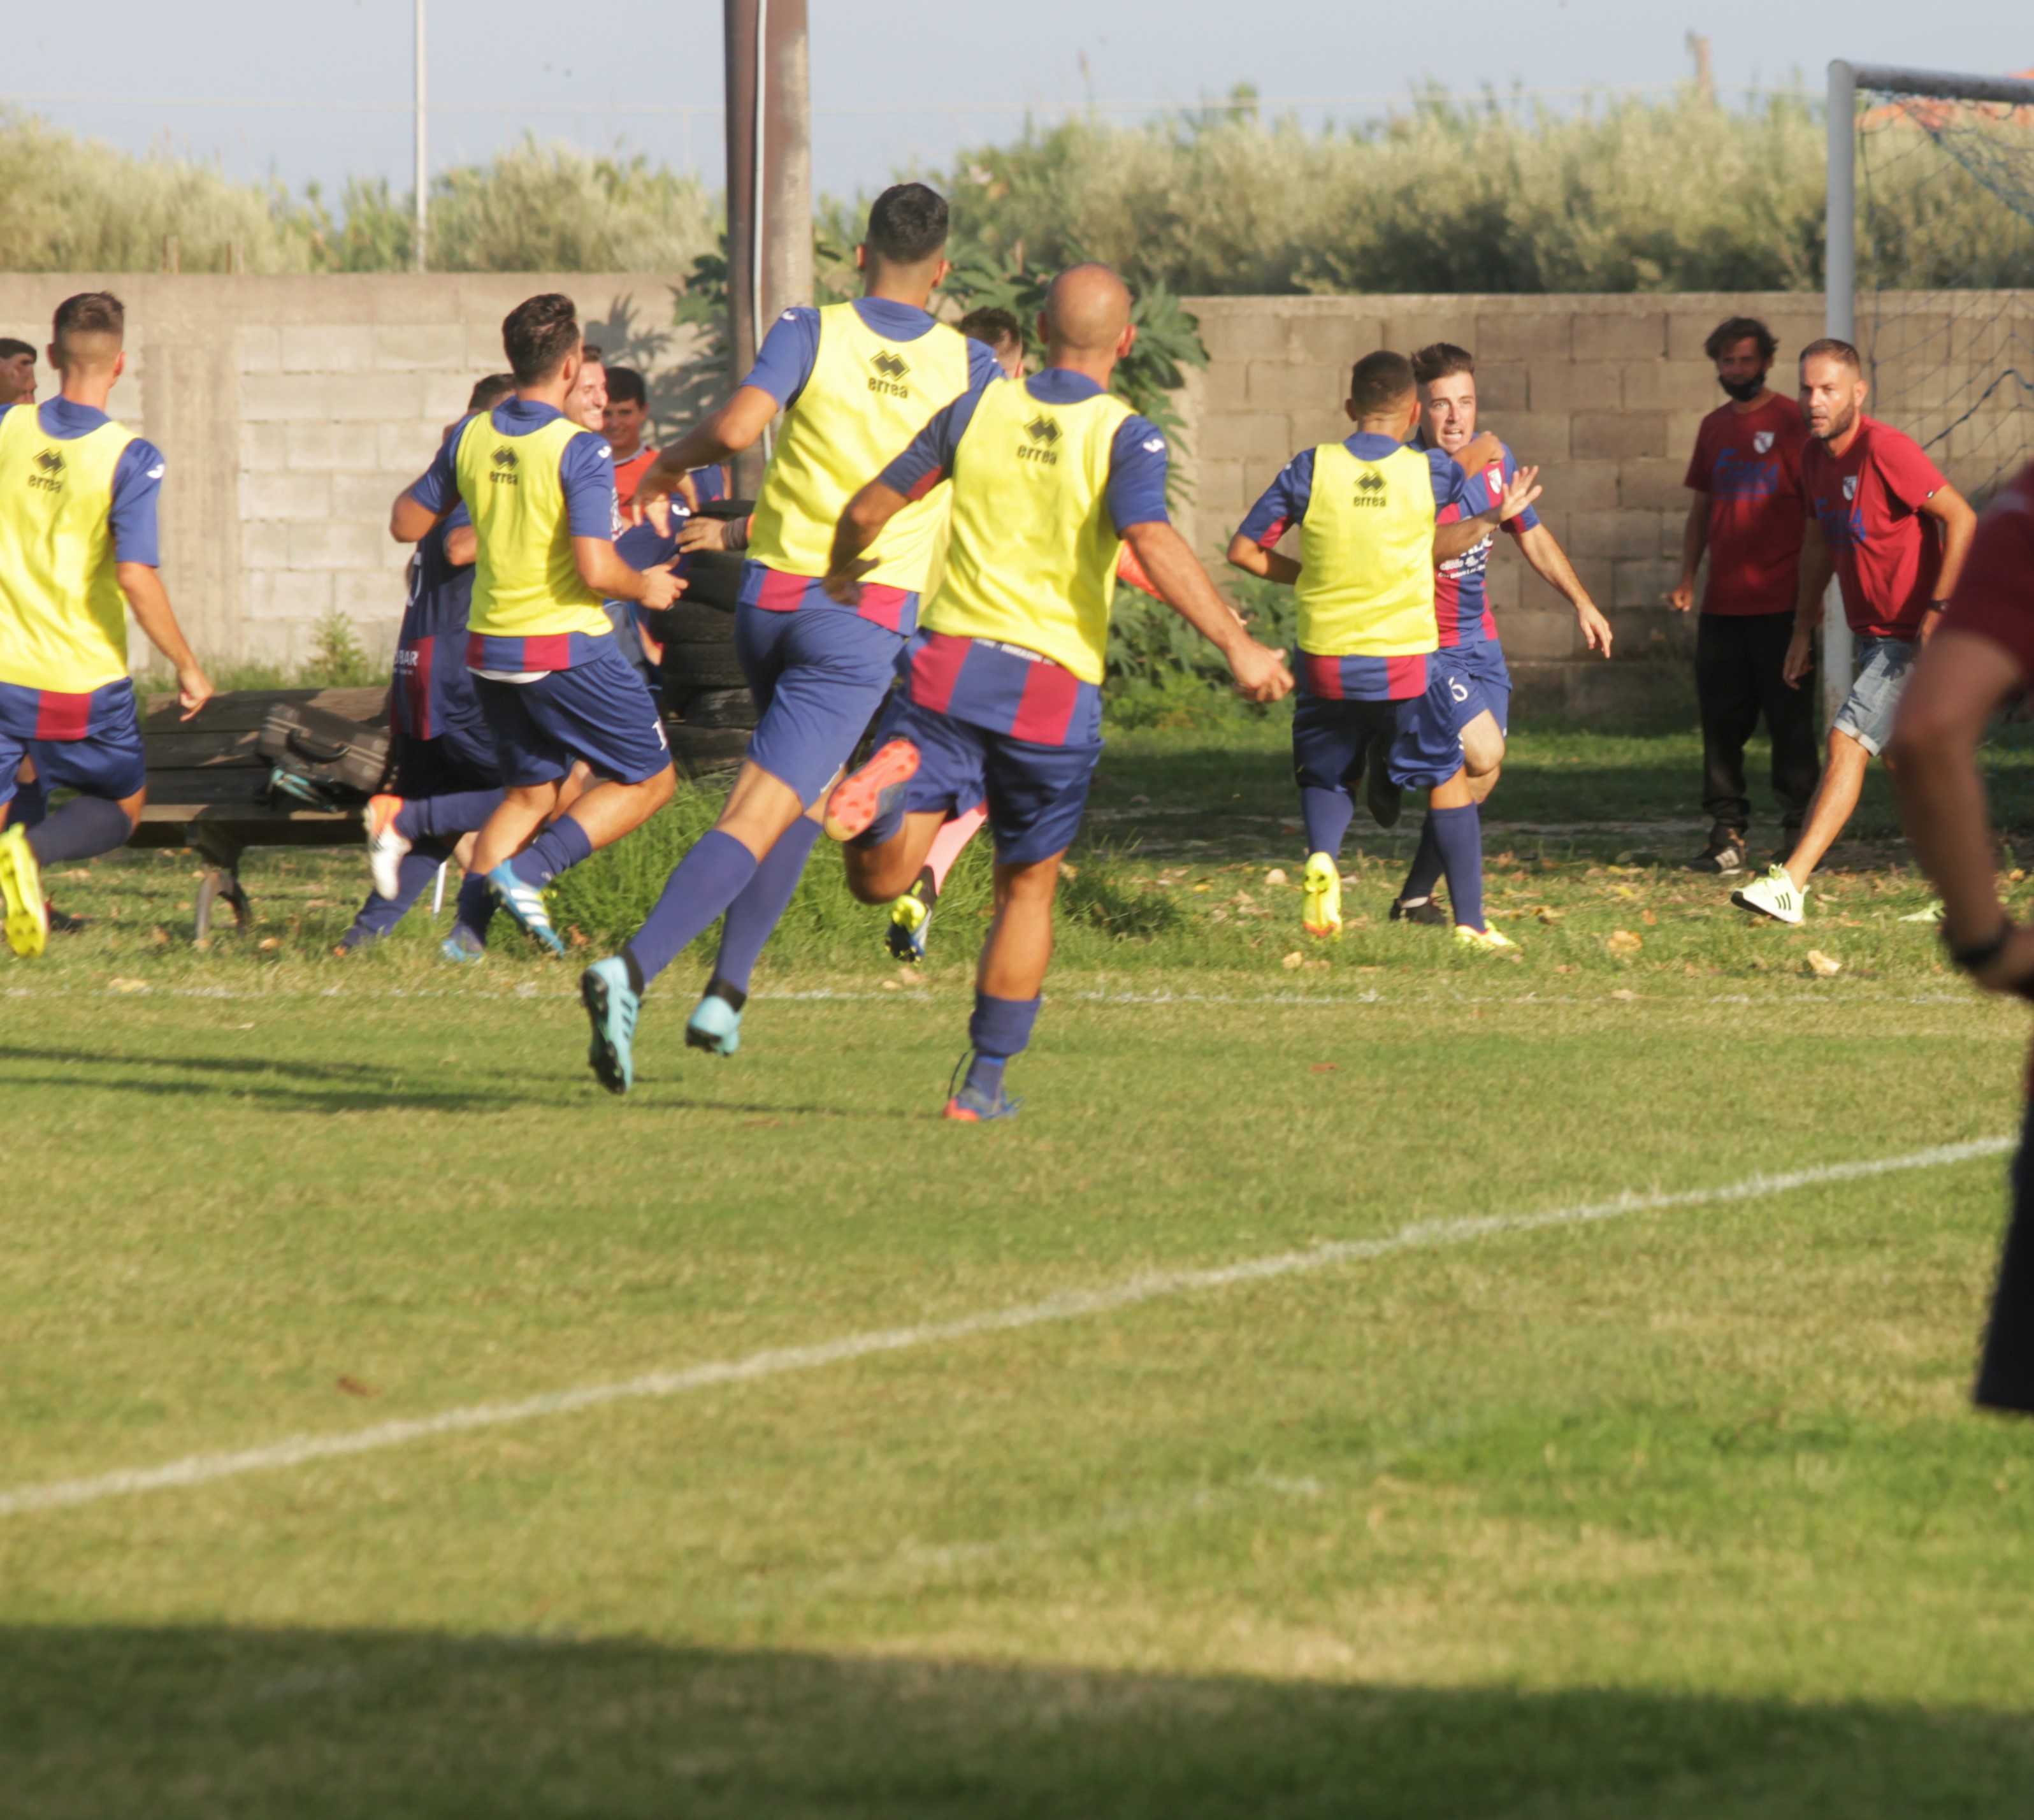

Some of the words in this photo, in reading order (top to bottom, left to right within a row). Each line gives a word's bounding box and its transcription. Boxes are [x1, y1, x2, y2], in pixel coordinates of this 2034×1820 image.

[868, 377, 908, 399] errea
[1016, 445, 1057, 465] errea
[27, 475, 62, 494] errea
[489, 471, 518, 486] errea
[1353, 496, 1387, 507] errea
[1448, 677, 1468, 702] 6
